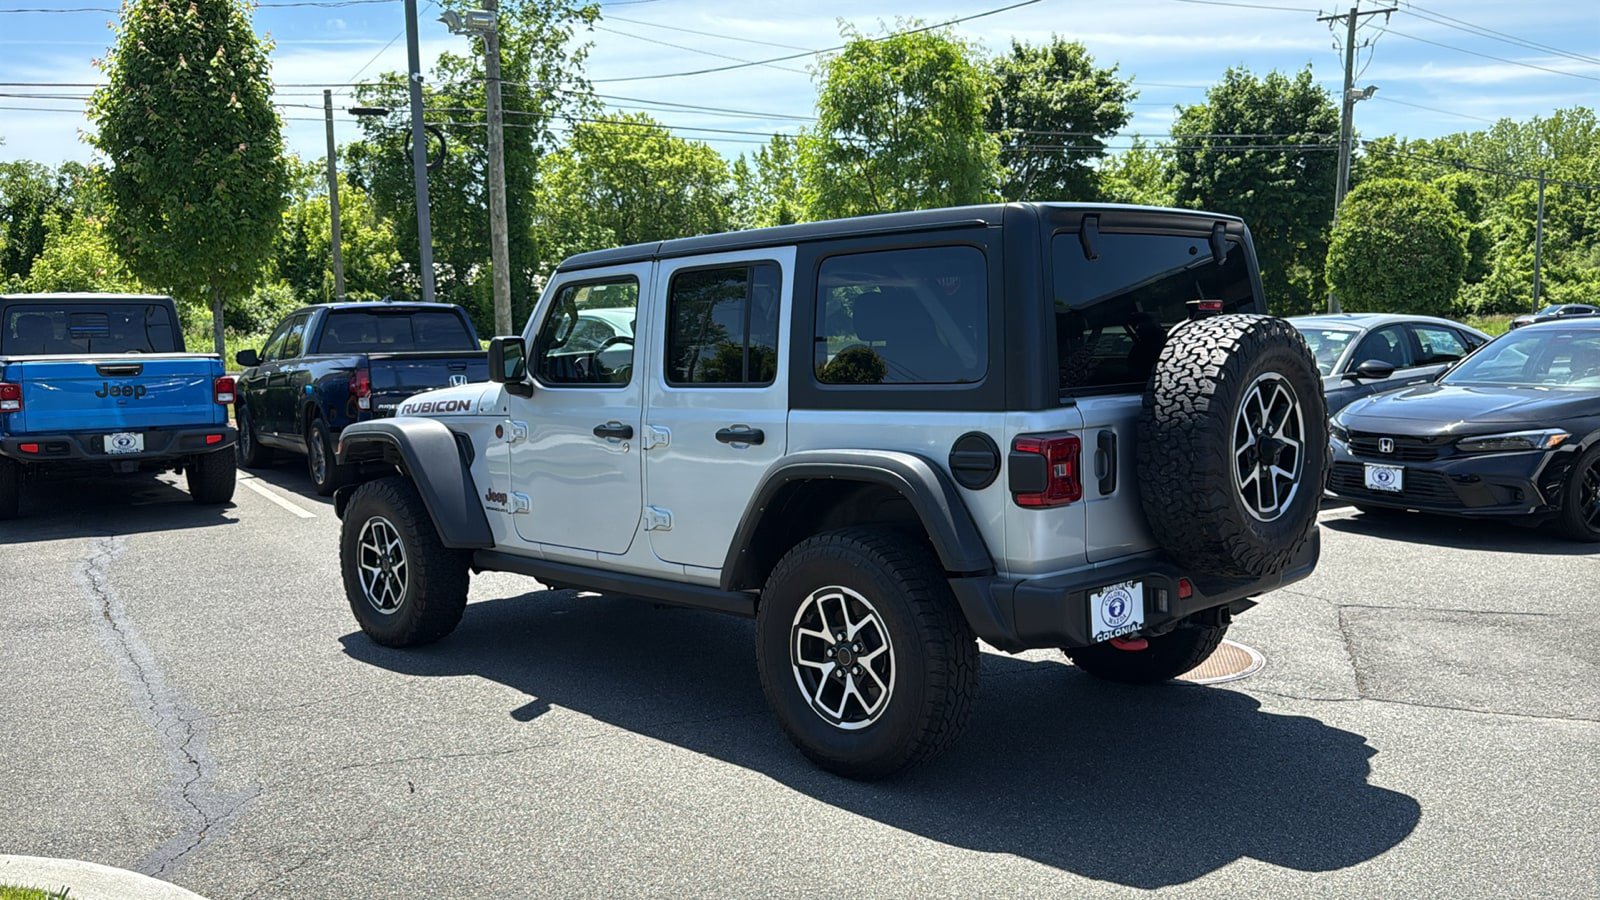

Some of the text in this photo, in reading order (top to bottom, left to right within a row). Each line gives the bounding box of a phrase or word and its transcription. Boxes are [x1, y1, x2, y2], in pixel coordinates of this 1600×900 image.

[95, 382, 147, 400] Jeep
[401, 400, 472, 414] RUBICON
[485, 488, 508, 506] Jeep
[1105, 591, 1129, 606] COLONIAL
[1097, 624, 1142, 642] COLONIAL
